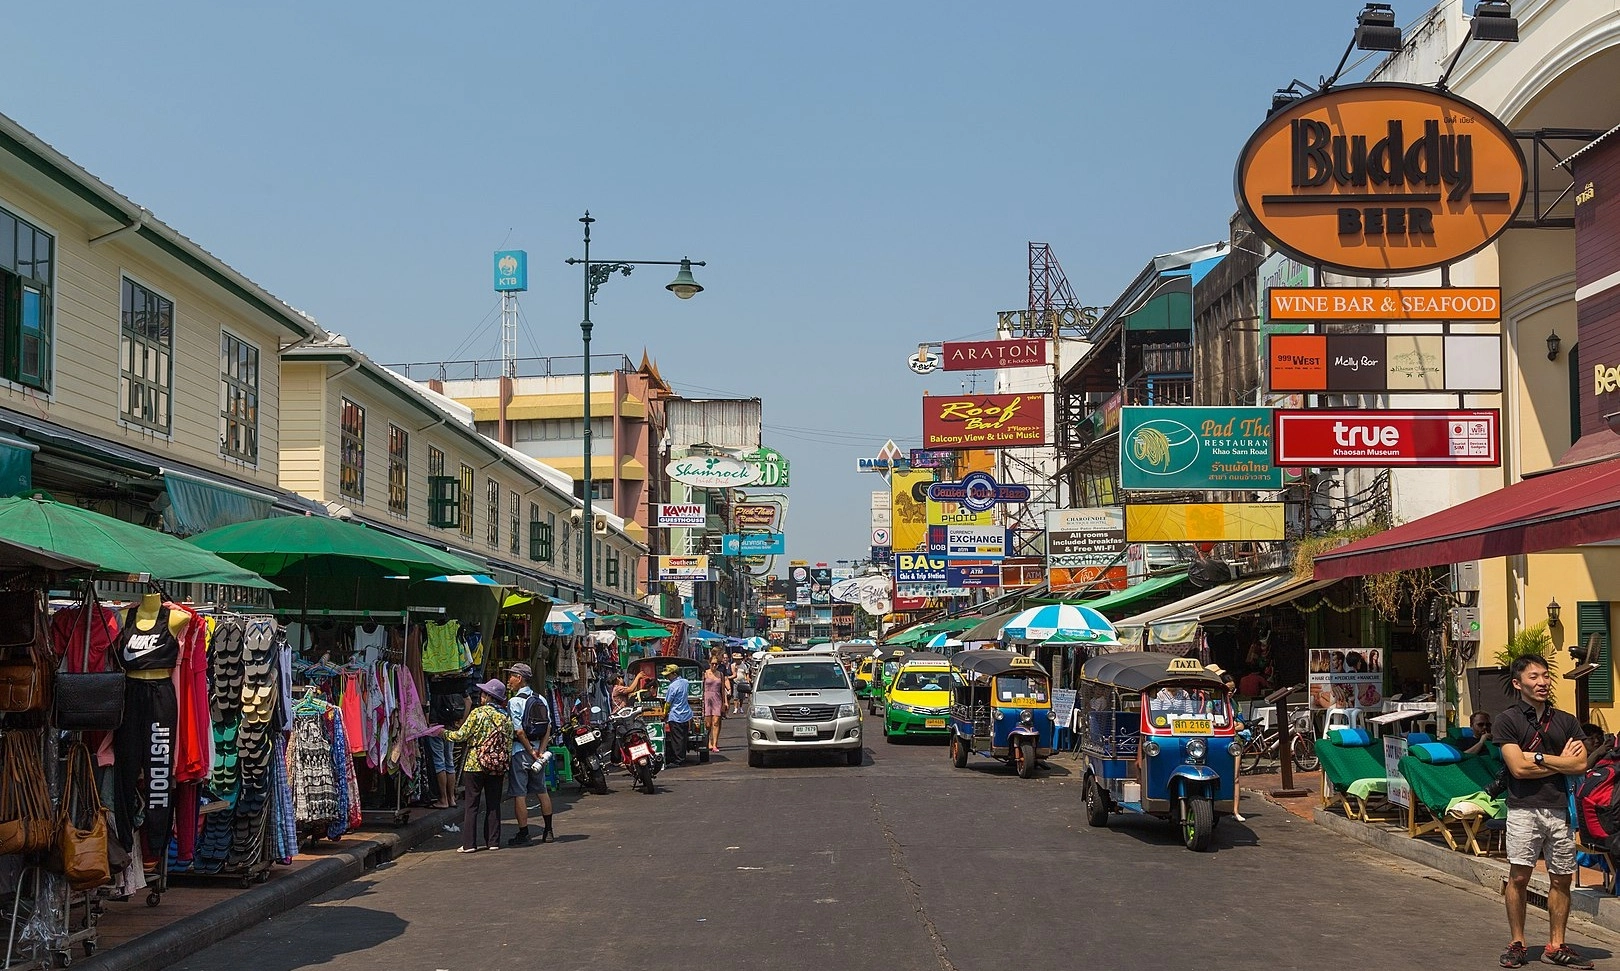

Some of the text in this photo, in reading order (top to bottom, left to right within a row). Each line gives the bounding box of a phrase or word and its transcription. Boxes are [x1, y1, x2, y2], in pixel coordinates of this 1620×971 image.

[1291, 118, 1472, 202] Buddy
[1337, 207, 1435, 235] BEER
[1275, 296, 1496, 312] WINE BAR & SEAFOOD
[997, 306, 1110, 331] KHAOS
[952, 345, 1037, 360] ARATON
[1292, 355, 1320, 365] WEST
[1360, 355, 1379, 366] Bar
[940, 397, 1021, 422] Roof
[964, 417, 1003, 430] Bar
[1201, 417, 1236, 437] Pad
[930, 435, 962, 443] Balcony
[964, 434, 985, 442] View
[1016, 431, 1039, 439] Music
[1333, 421, 1400, 447] true
[675, 463, 750, 478] Shamrock
[1211, 460, 1268, 472] ร้านผัดไทย
[934, 487, 1026, 498] Center Point Plaza
[663, 506, 700, 516] KAWIN
[900, 555, 945, 570] BAG
[127, 634, 160, 650] NIKE
[1174, 660, 1197, 668] TAXI
[1190, 721, 1210, 729] 2166
[149, 722, 170, 809] JUST DO IT.
